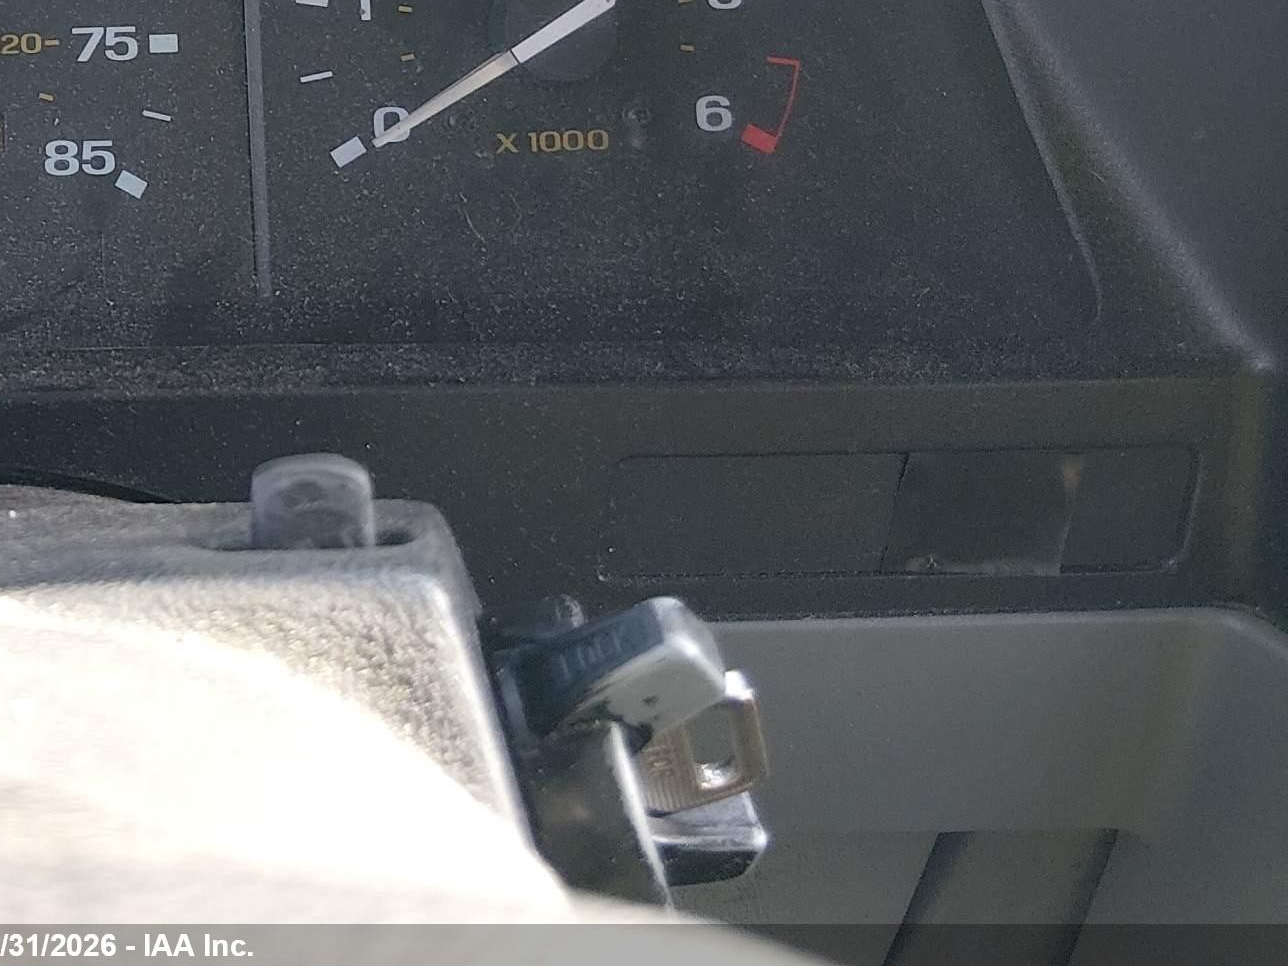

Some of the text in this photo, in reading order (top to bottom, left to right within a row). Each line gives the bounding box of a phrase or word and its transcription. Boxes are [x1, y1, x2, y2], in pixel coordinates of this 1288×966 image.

[72, 26, 138, 61] 75
[373, 106, 411, 143] 0
[696, 96, 732, 131] 6
[45, 140, 115, 175] 85
[497, 130, 608, 154] X 1000
